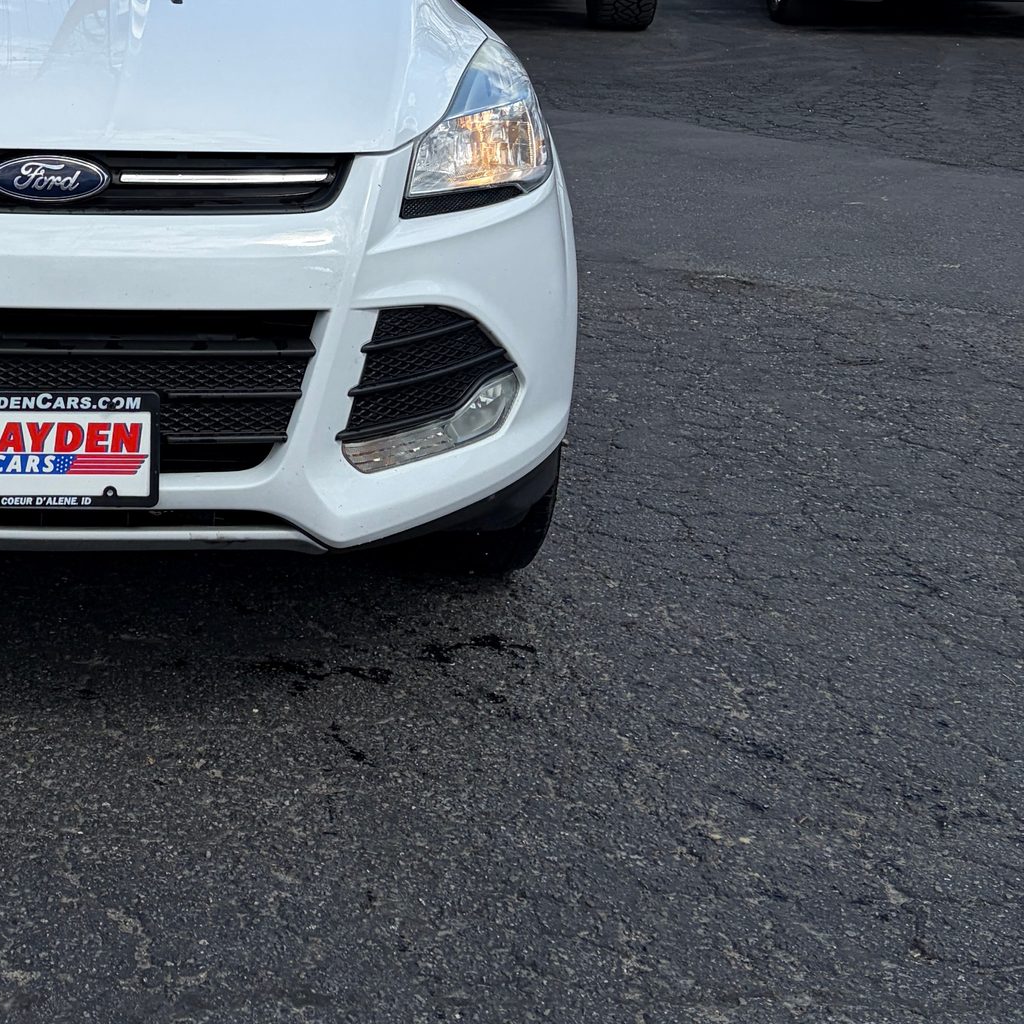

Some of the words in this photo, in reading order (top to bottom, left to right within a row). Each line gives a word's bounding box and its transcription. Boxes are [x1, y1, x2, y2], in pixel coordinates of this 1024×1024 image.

[13, 162, 81, 192] Ford
[1, 497, 33, 506] COEUR
[81, 497, 92, 506] ID
